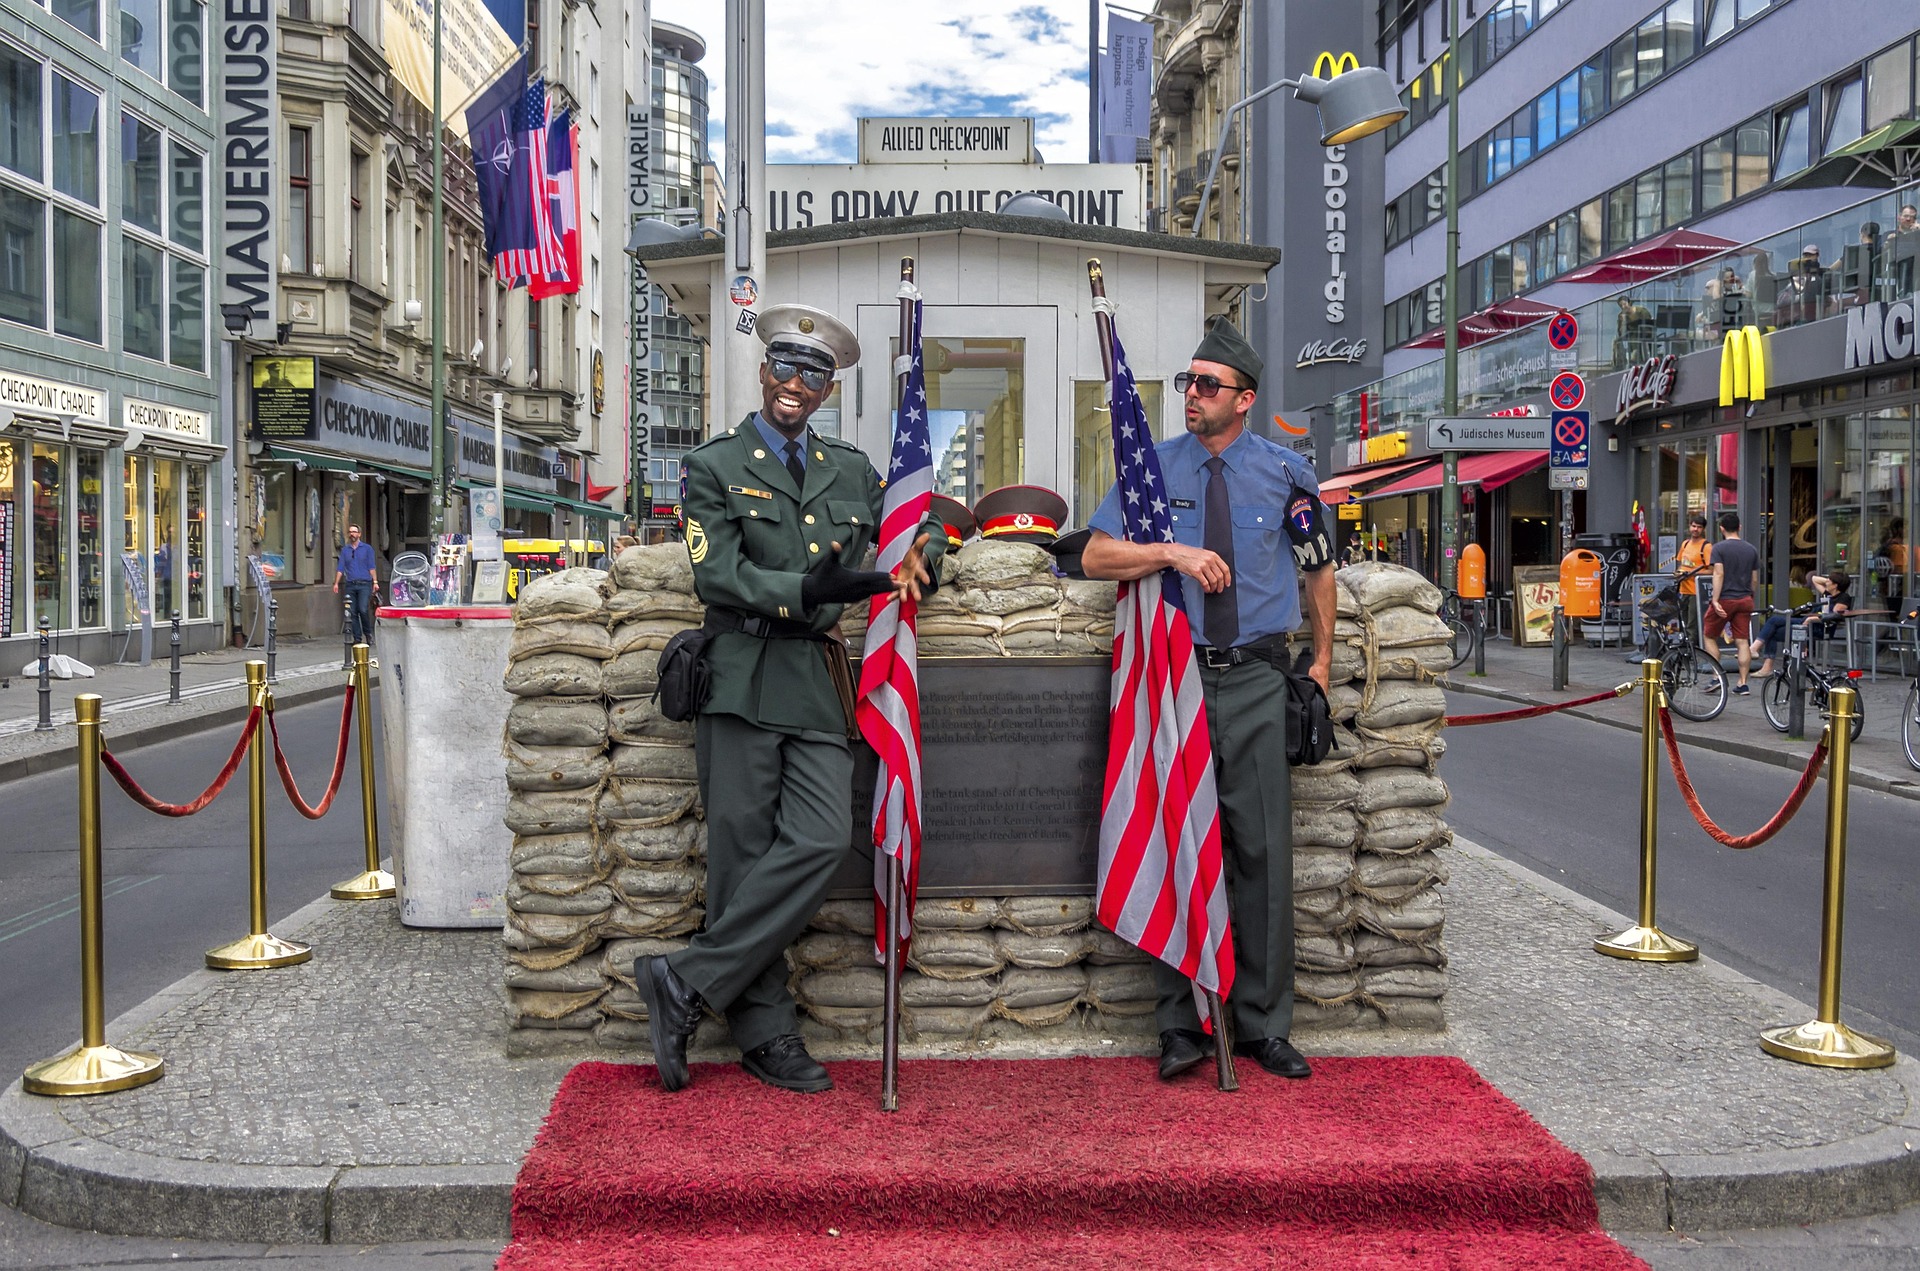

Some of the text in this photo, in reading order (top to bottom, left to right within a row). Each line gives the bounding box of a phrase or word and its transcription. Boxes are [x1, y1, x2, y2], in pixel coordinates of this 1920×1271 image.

[1113, 34, 1124, 88] happiness.
[1135, 37, 1148, 72] Design
[1123, 35, 1136, 128] is nothing without
[881, 126, 1011, 151] ALLIED CHECKPOINT
[630, 113, 649, 206] CHARLIE
[831, 190, 919, 223] ARMY
[1297, 336, 1367, 364] McCafé
[1, 378, 95, 416] CHECKPOINT CHARLIE
[1615, 354, 1674, 417] McCafé
[129, 404, 201, 435] CHECKPOINT CHARLIE
[324, 397, 391, 444] CHECKPOINT
[394, 416, 430, 452] CHARLIE
[1458, 428, 1545, 440] Jüdisches Museum
[1292, 533, 1328, 566] MP
[1001, 706, 1013, 715] an
[1015, 704, 1032, 715] den
[1026, 693, 1040, 701] am
[1042, 690, 1094, 703] Checkpoint
[1001, 718, 1037, 729] General
[1039, 718, 1069, 729] Lucius
[920, 733, 954, 743] andeln
[956, 732, 970, 743] bei
[971, 732, 987, 743] der
[987, 732, 1048, 746] Verteidigung
[1050, 732, 1065, 742] der
[932, 787, 947, 798] the
[948, 787, 969, 798] tank
[972, 787, 1016, 798] stand-off
[1019, 789, 1026, 797] at
[1028, 787, 1079, 800] Checkpoint
[925, 816, 966, 827] President
[969, 816, 991, 827] John
[1048, 815, 1060, 825] for
[930, 802, 948, 812] and
[951, 803, 959, 812] in
[960, 801, 1003, 815] gratitude
[1005, 802, 1014, 812] to
[1029, 801, 1065, 811] General
[924, 831, 971, 843] defending
[973, 831, 987, 841] the
[989, 829, 1027, 840] freedom
[1028, 829, 1038, 840] of
